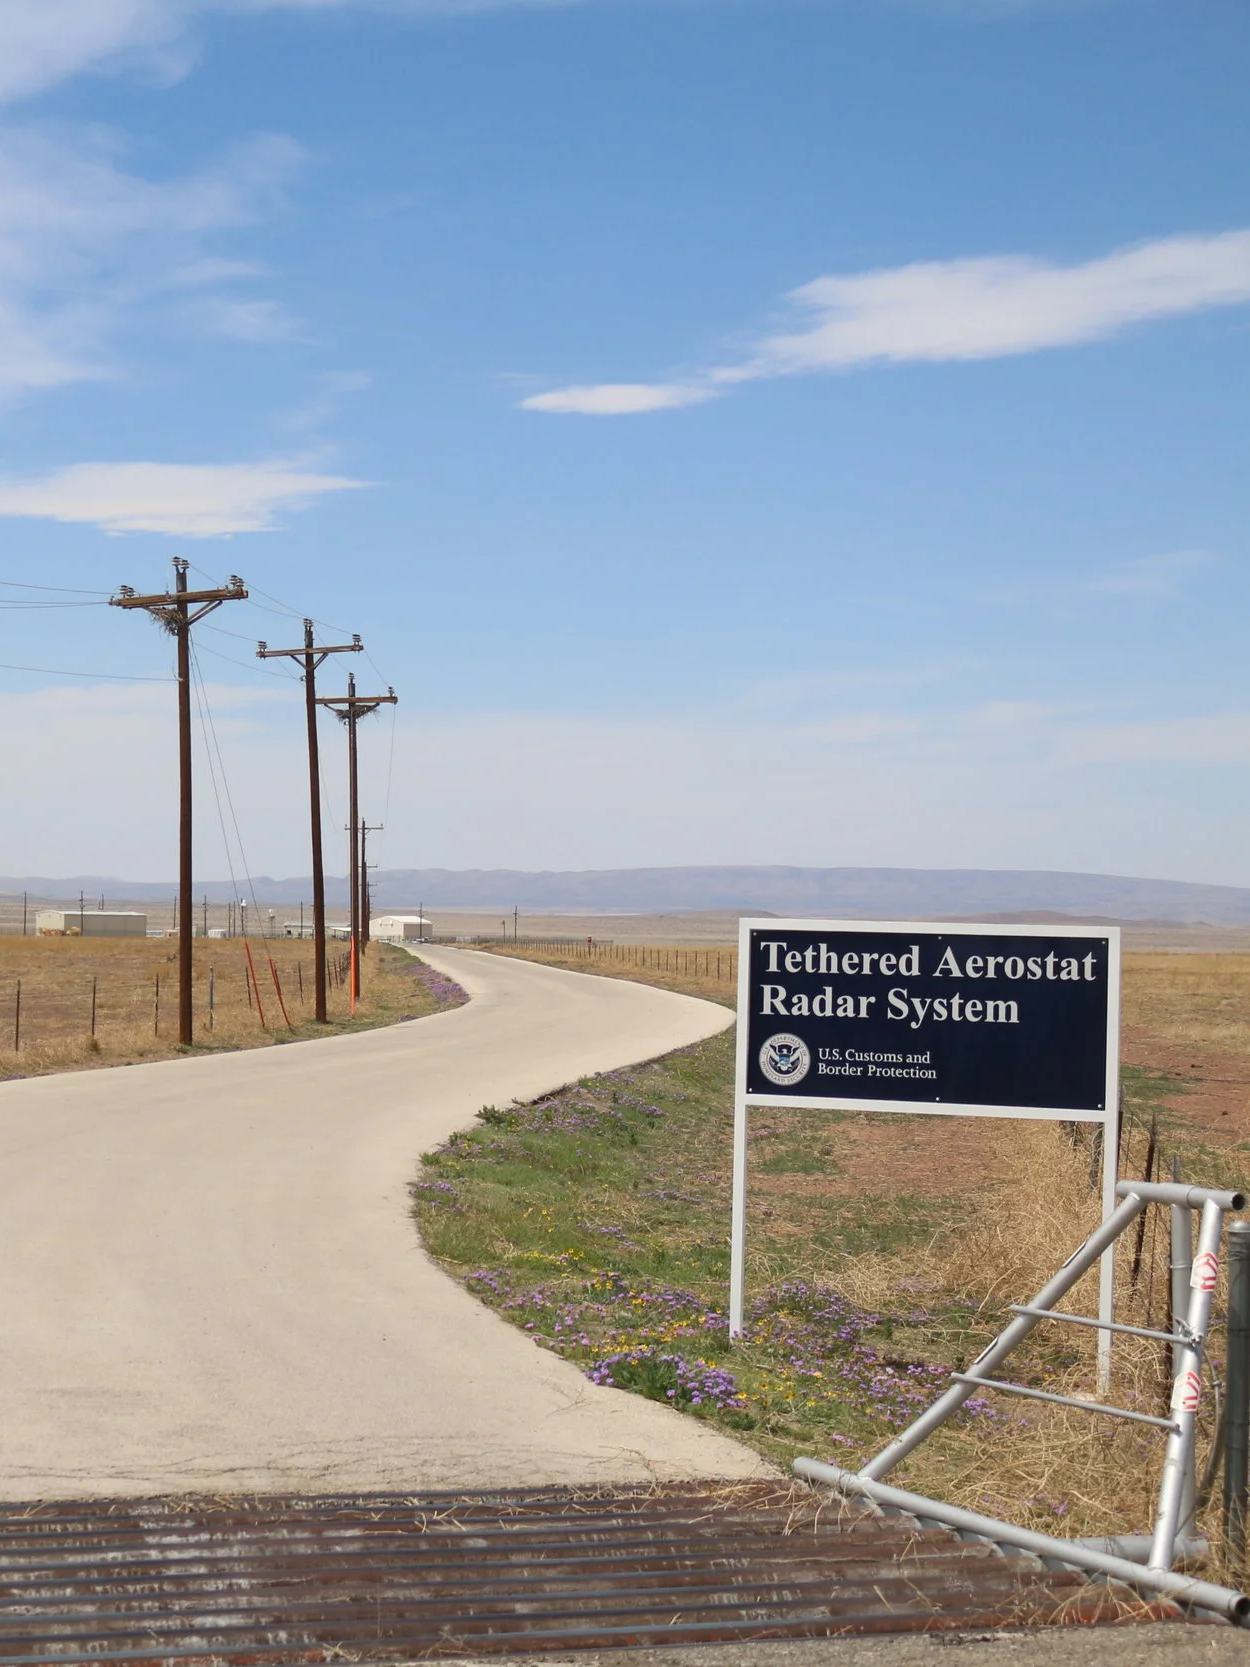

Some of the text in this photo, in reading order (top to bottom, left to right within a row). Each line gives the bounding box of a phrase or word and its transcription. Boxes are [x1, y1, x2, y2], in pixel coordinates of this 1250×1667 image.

[761, 942, 1096, 981] Tethered Aerostat
[760, 985, 1019, 1029] Radar System
[819, 1048, 930, 1064] U.S. Customs and
[818, 1062, 936, 1078] Border Protection
